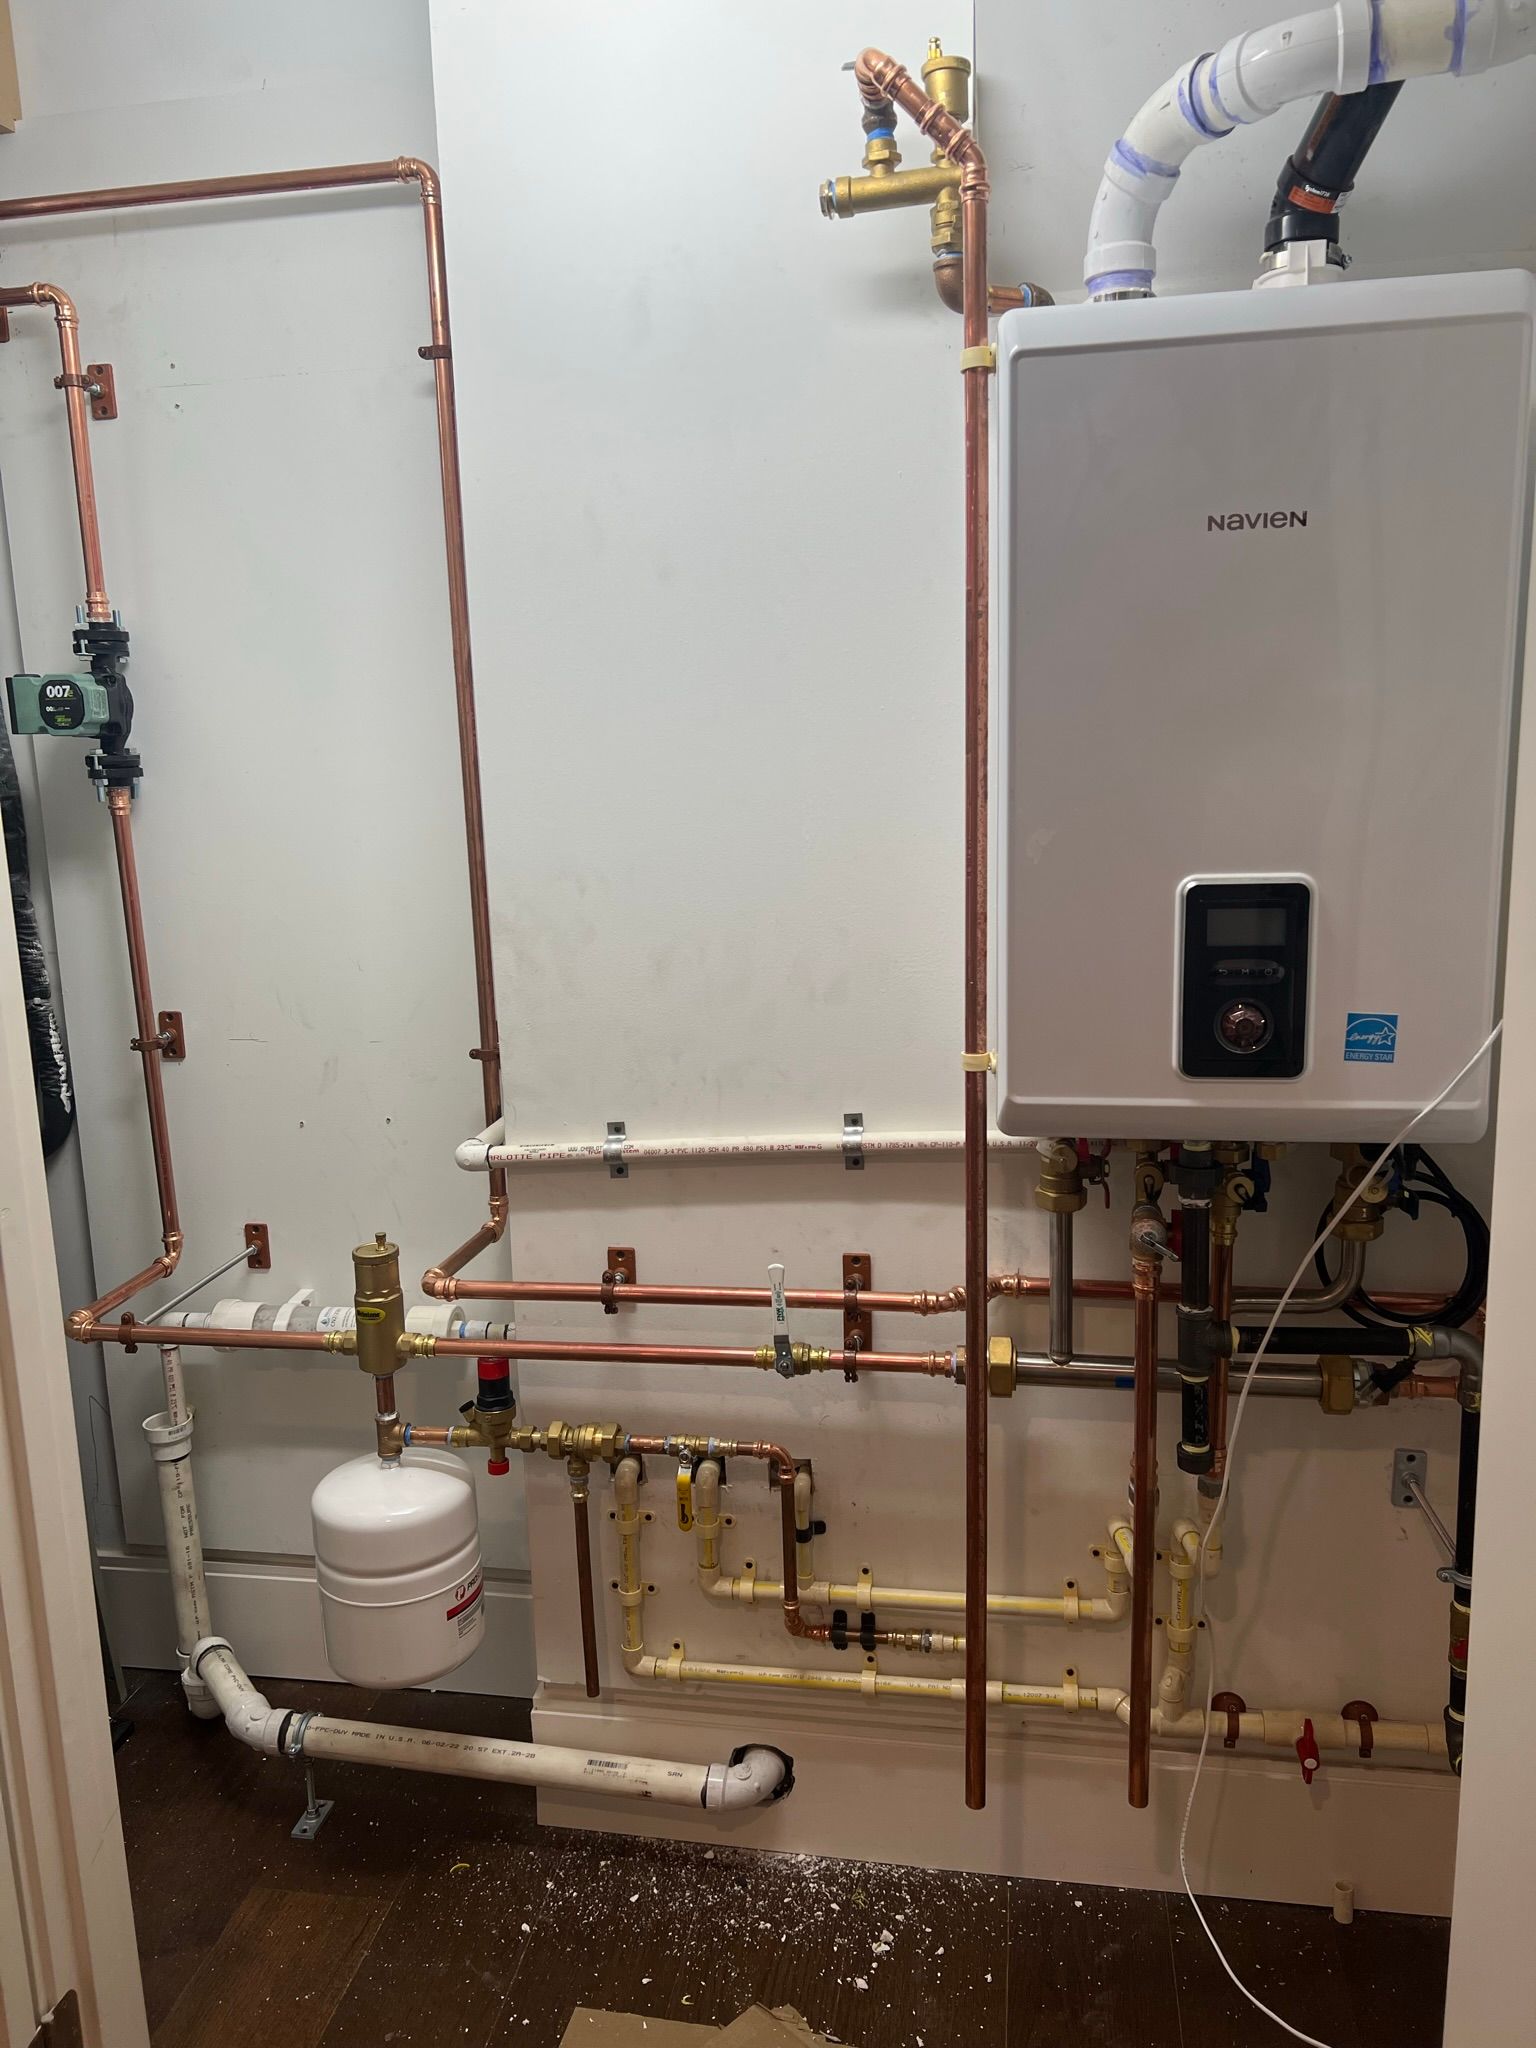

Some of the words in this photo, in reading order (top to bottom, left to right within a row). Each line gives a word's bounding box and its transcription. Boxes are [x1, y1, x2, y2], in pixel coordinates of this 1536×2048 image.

[1345, 1052, 1373, 1061] ENERGY
[1374, 1053, 1393, 1062] STAR
[488, 1153, 534, 1161] ARLOTTE
[351, 1731, 371, 1739] MADE
